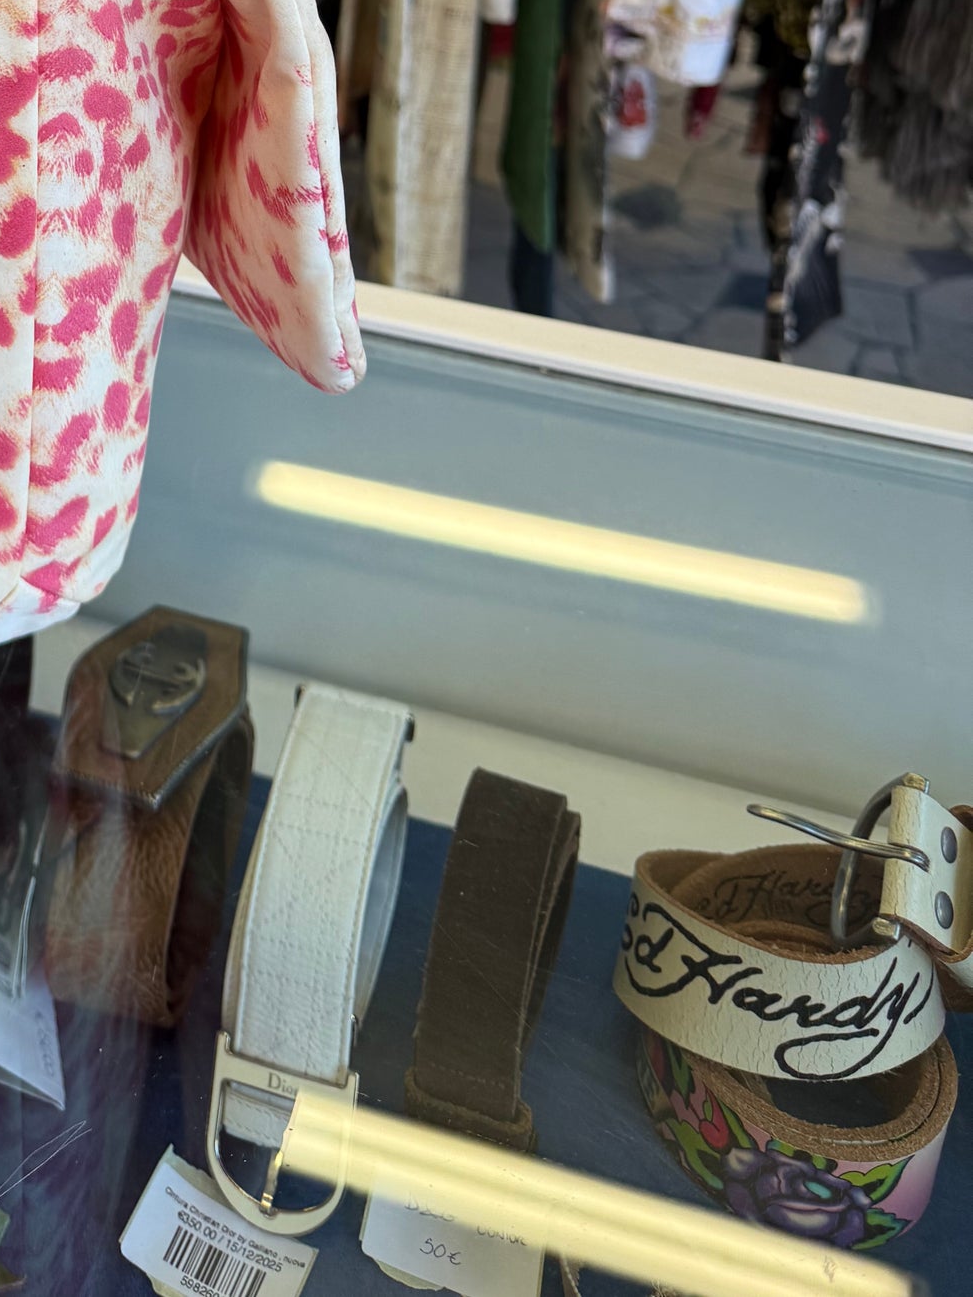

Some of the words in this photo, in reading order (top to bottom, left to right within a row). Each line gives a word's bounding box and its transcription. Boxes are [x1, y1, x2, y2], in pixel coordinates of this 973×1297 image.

[625, 902, 921, 1082] Hardy
[177, 1210, 217, 1240] €350.00
[226, 1239, 283, 1272] 15/12/2025
[189, 1205, 220, 1229] Christian
[221, 1224, 237, 1237] Dior
[237, 1234, 247, 1244] by
[248, 1240, 278, 1258] Galliano
[419, 1238, 461, 1265] 50€
